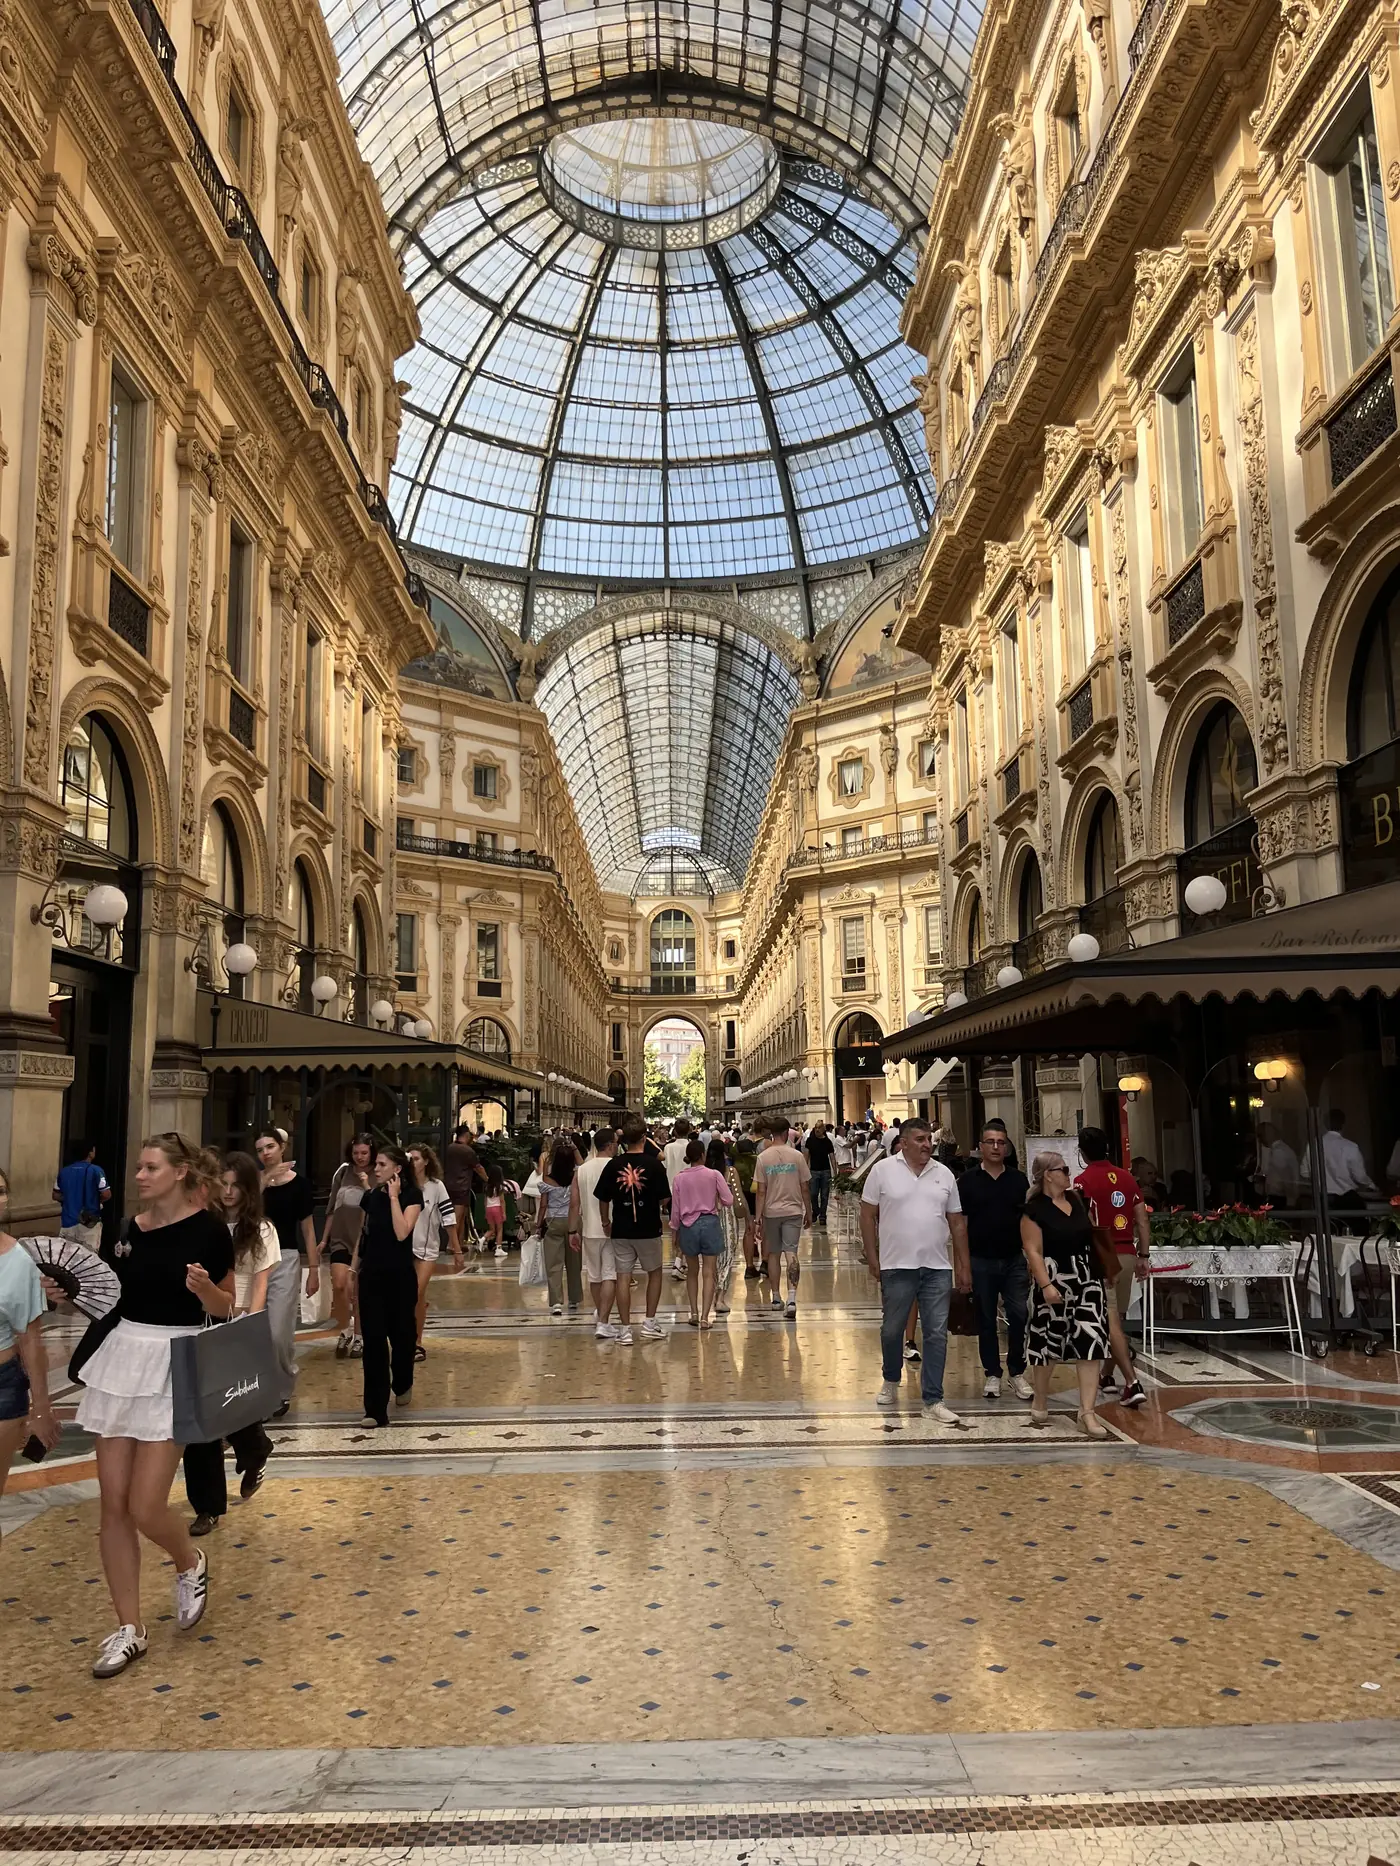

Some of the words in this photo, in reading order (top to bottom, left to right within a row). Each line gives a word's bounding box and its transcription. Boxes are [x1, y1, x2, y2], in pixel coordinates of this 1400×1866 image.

[1260, 929, 1305, 949] Bar
[230, 1008, 269, 1044] CRACCO
[222, 1373, 260, 1407] Subdued
